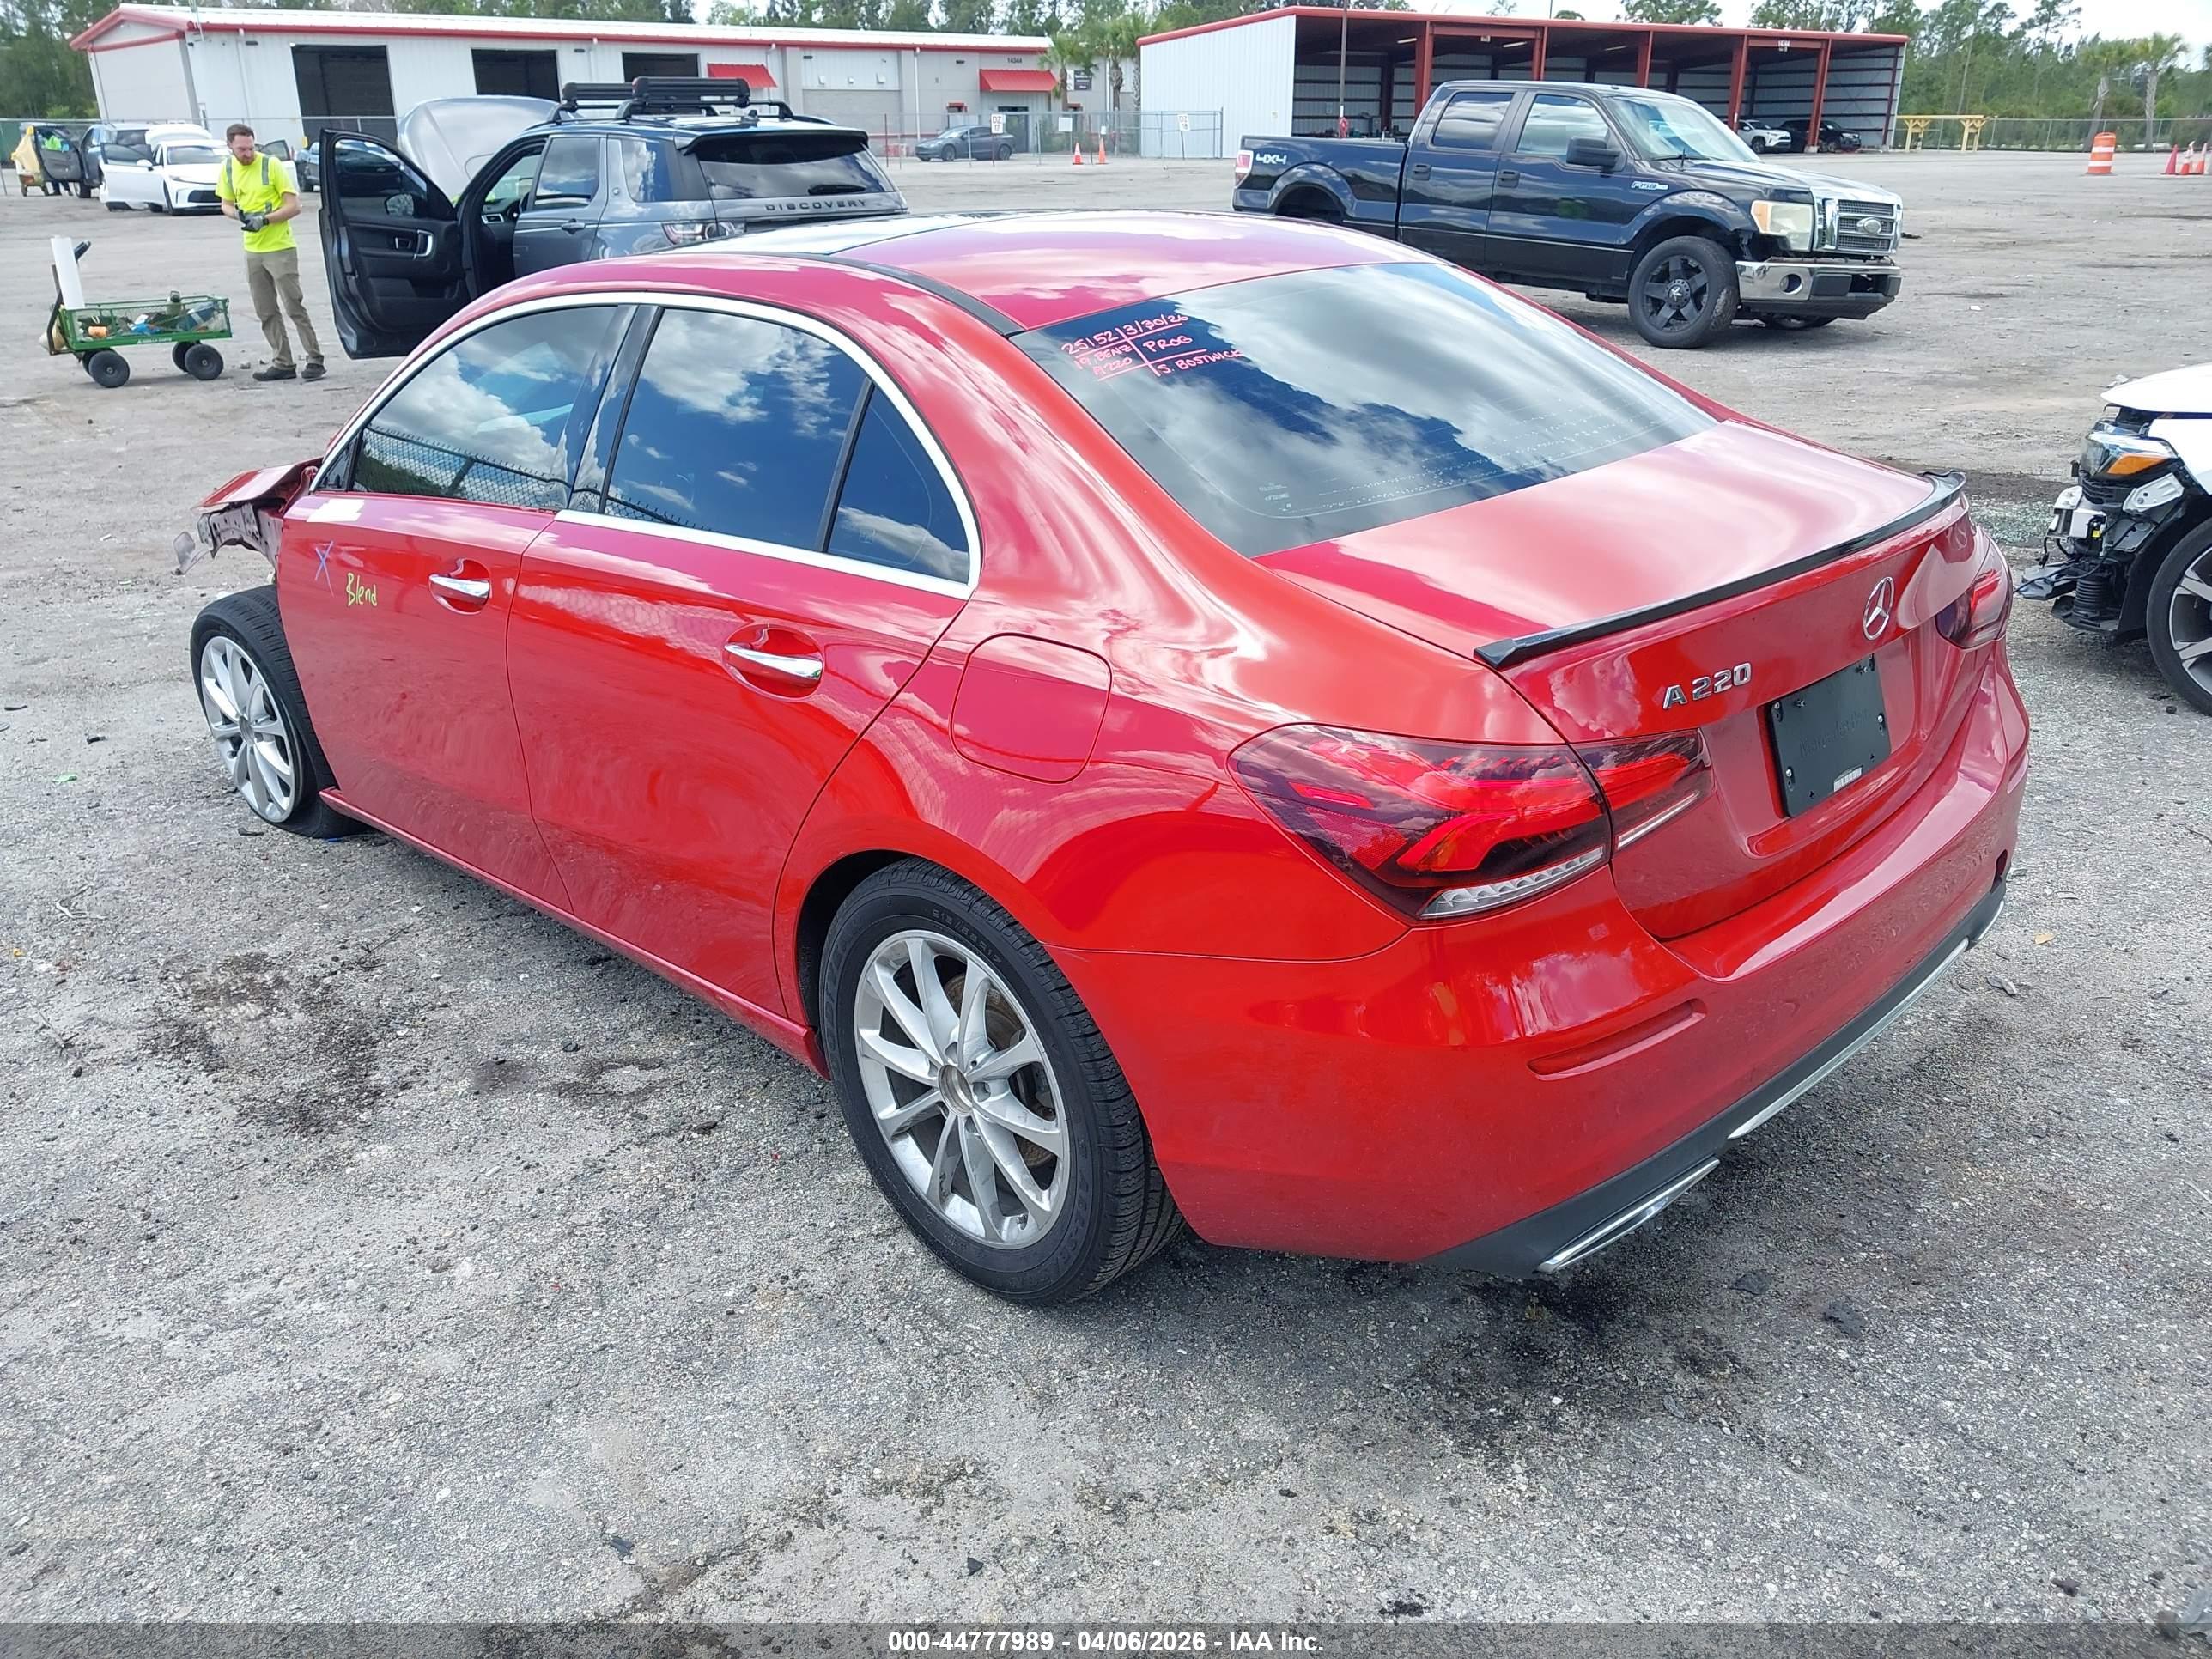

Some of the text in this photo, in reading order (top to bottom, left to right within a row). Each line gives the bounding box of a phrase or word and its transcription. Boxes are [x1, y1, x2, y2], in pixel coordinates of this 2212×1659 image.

[765, 199, 866, 211] DISCOVERY
[1060, 313, 1189, 354] 25152 3/30/26
[1174, 349, 1245, 370] BOSTWICK
[346, 572, 378, 606] Blend
[1662, 662, 1752, 709] A 220
